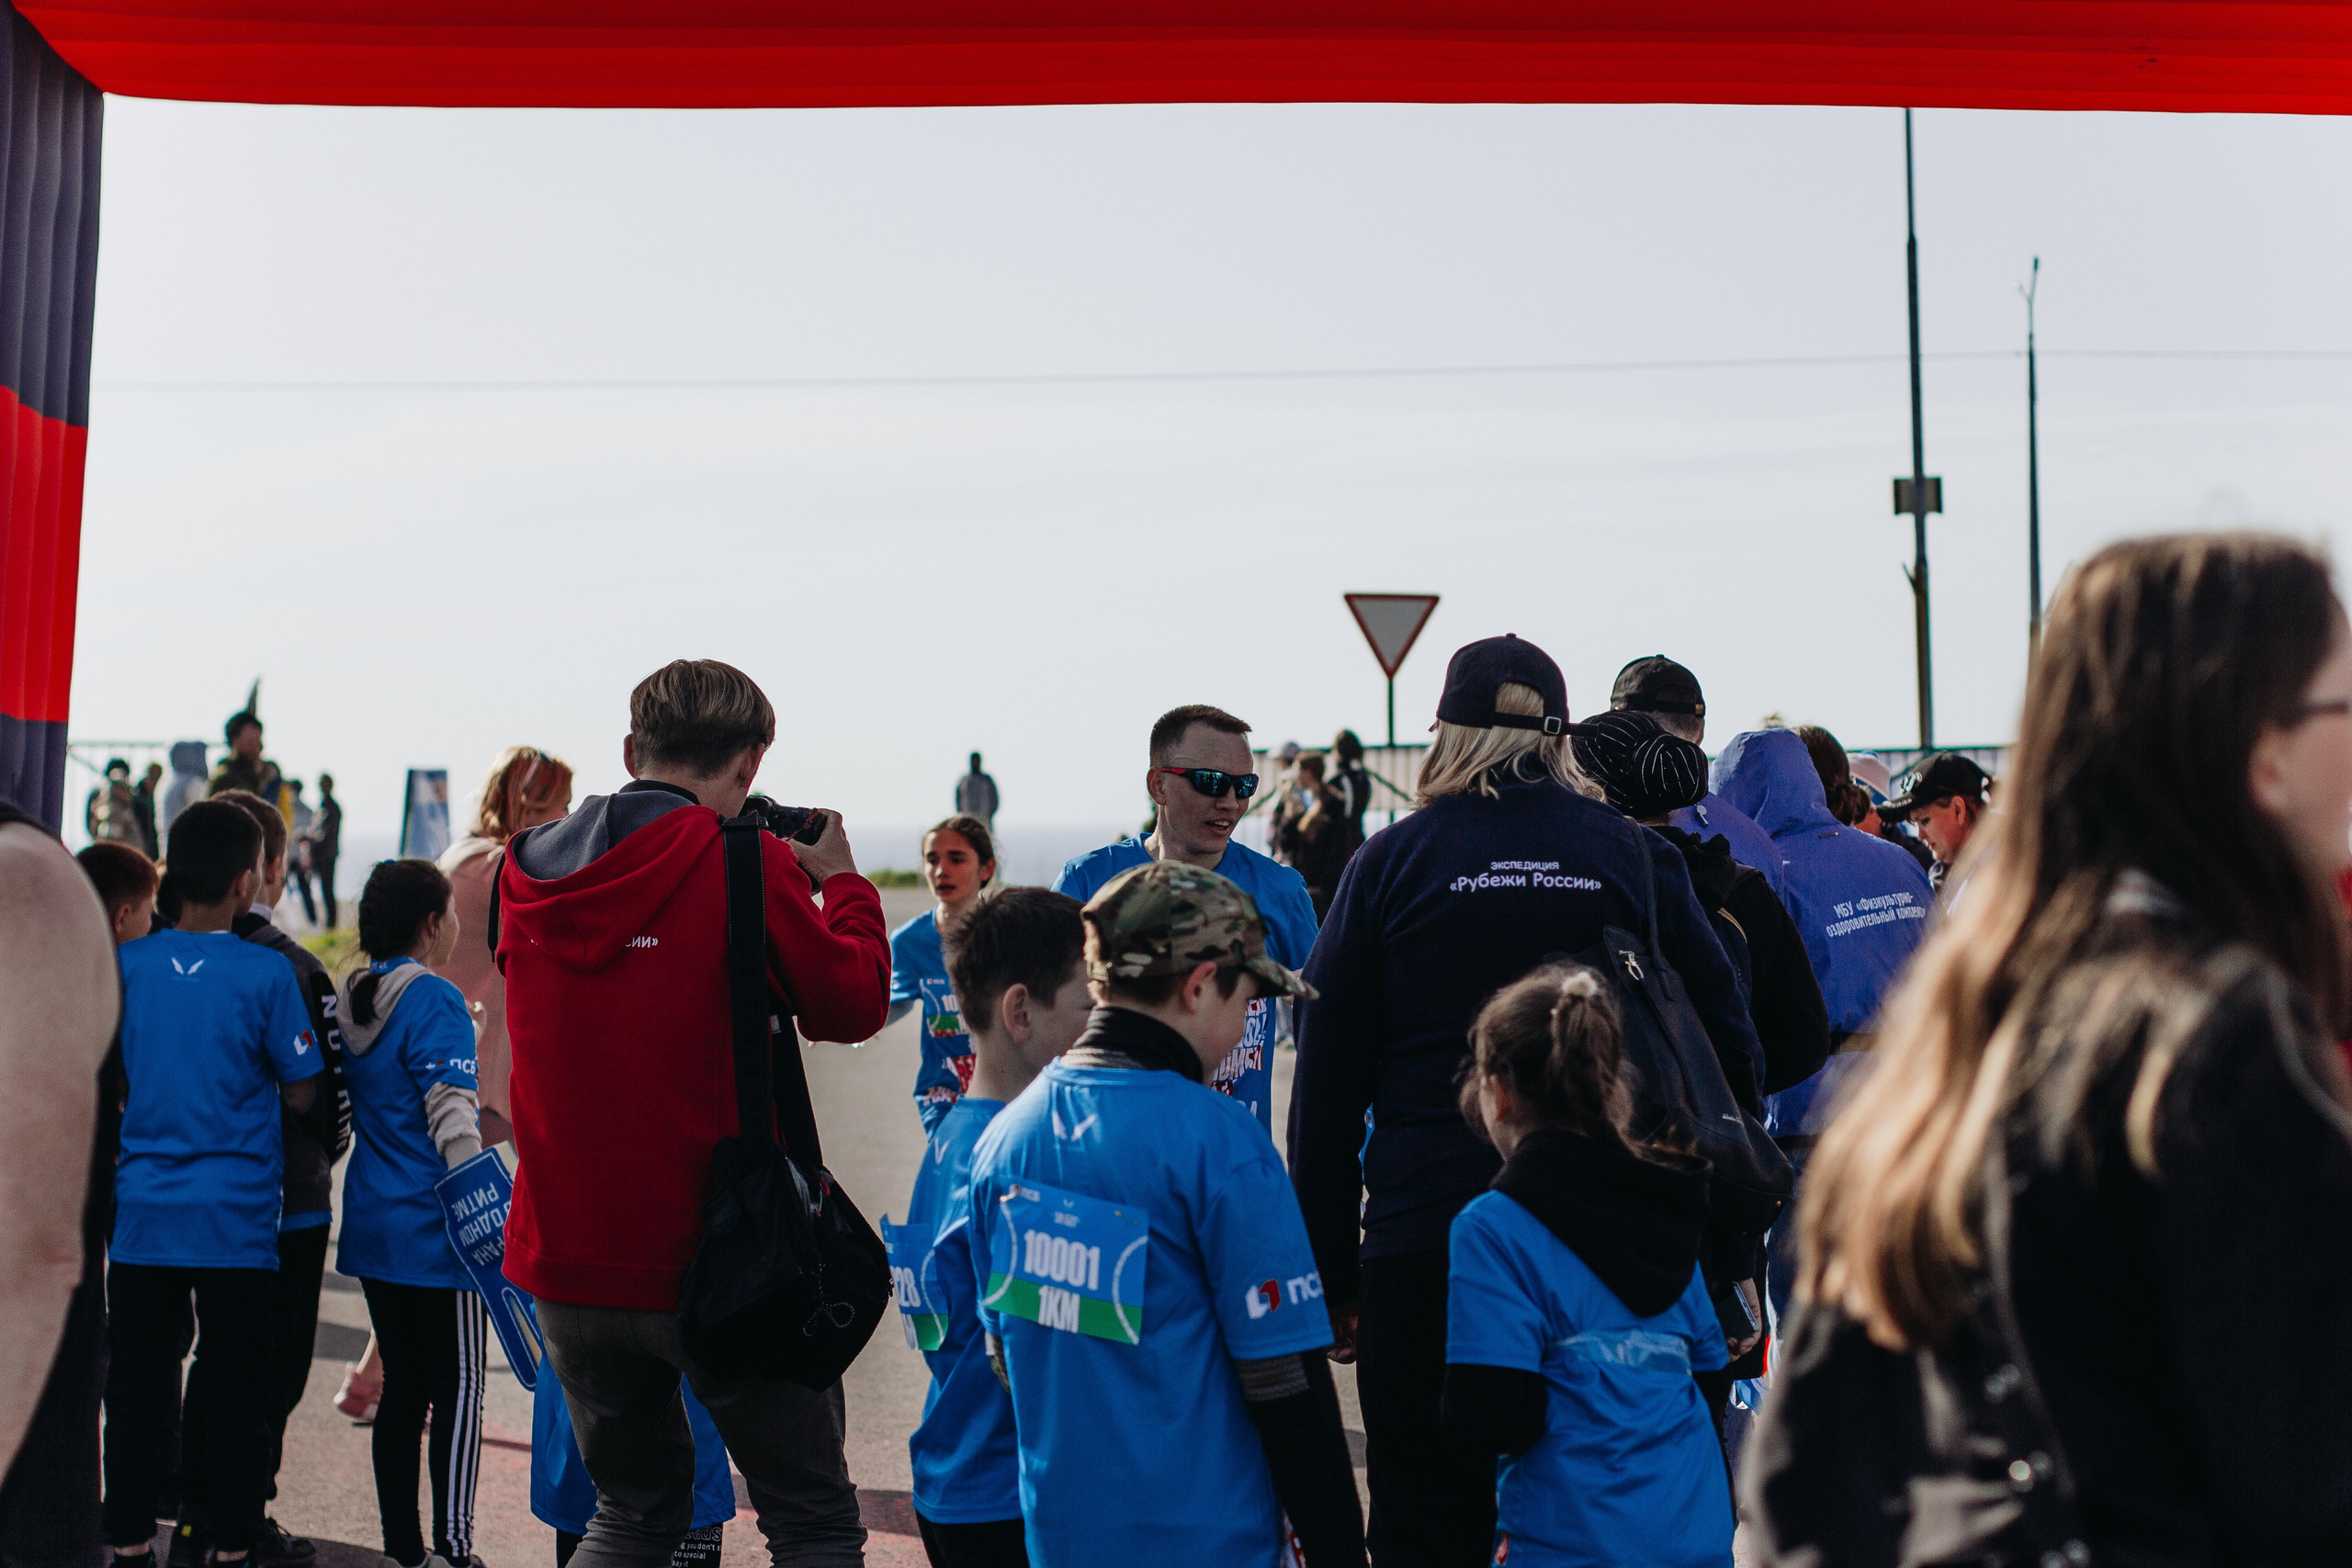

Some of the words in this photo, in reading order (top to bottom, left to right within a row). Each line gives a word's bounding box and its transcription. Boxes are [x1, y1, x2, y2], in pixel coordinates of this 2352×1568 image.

[1490, 861, 1560, 872] ЭКСПЕДИЦИЯ
[1450, 873, 1526, 893] «Рубежи
[1532, 872, 1602, 891] России»
[1833, 900, 1854, 919] МБУ
[1826, 908, 1897, 938] оздоровительный
[941, 993, 960, 1012] 10
[470, 1235, 505, 1267] РАНА
[1023, 1228, 1101, 1292] 10001
[697, 1542, 716, 1551] don't
